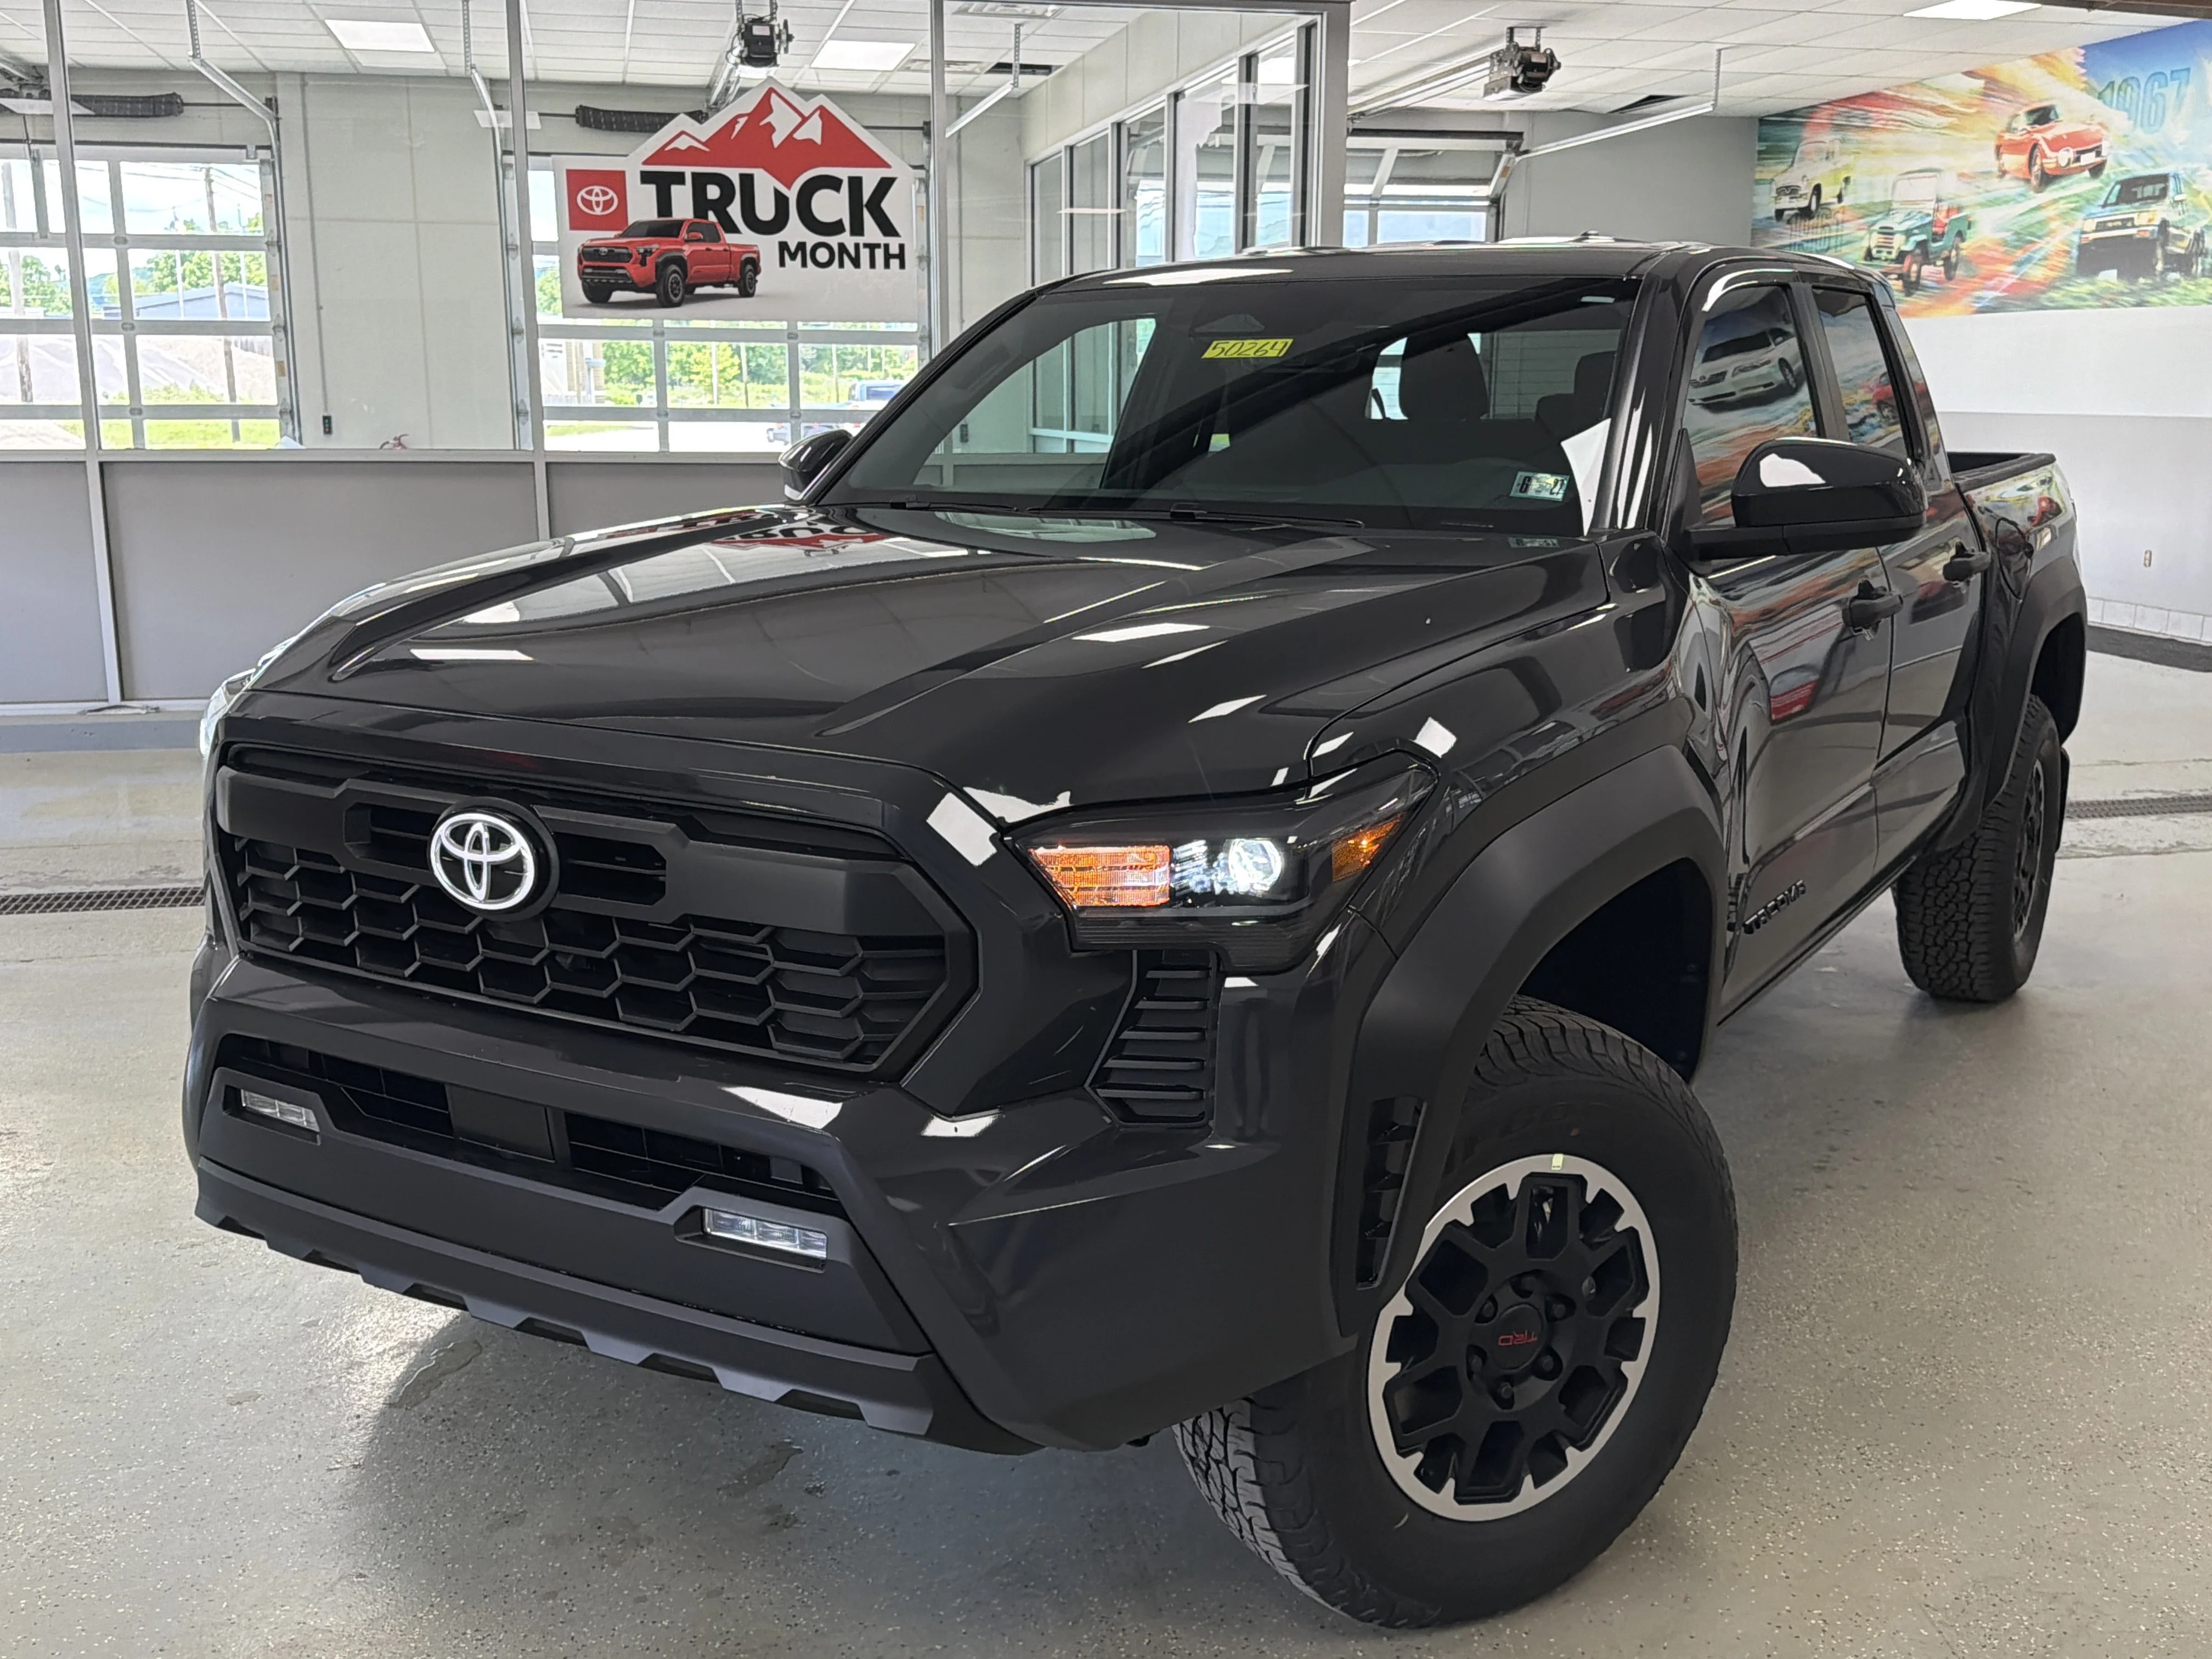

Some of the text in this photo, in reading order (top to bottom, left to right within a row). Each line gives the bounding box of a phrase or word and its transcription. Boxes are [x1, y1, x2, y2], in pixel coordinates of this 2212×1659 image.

[640, 170, 901, 238] TRUCK
[778, 241, 906, 270] MONTH
[1211, 341, 1289, 357] 50264
[1519, 476, 1532, 493] 6
[1498, 1329, 1538, 1346] TRD
